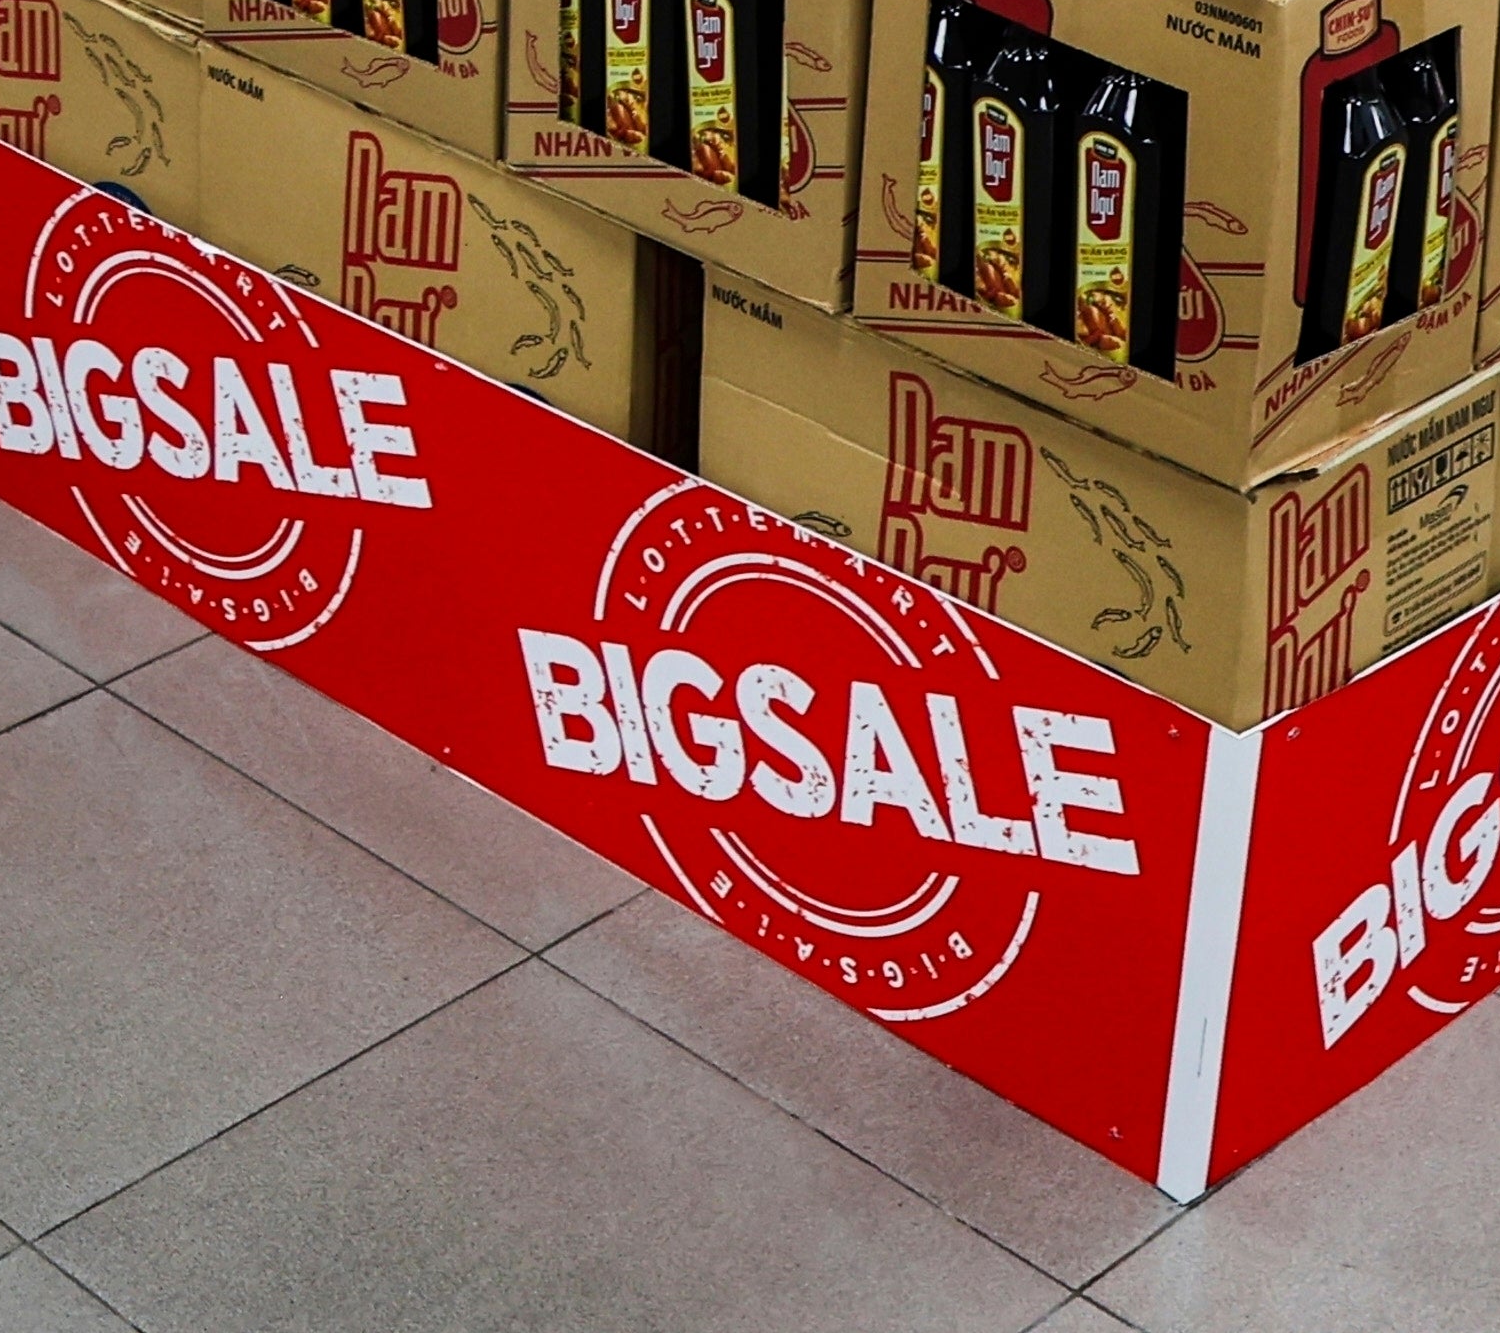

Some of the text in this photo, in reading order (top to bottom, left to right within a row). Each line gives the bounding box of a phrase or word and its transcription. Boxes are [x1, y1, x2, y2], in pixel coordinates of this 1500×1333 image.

[344, 130, 464, 273] Nam
[887, 371, 1034, 534] Nam
[517, 627, 1141, 876] BIGSALE
